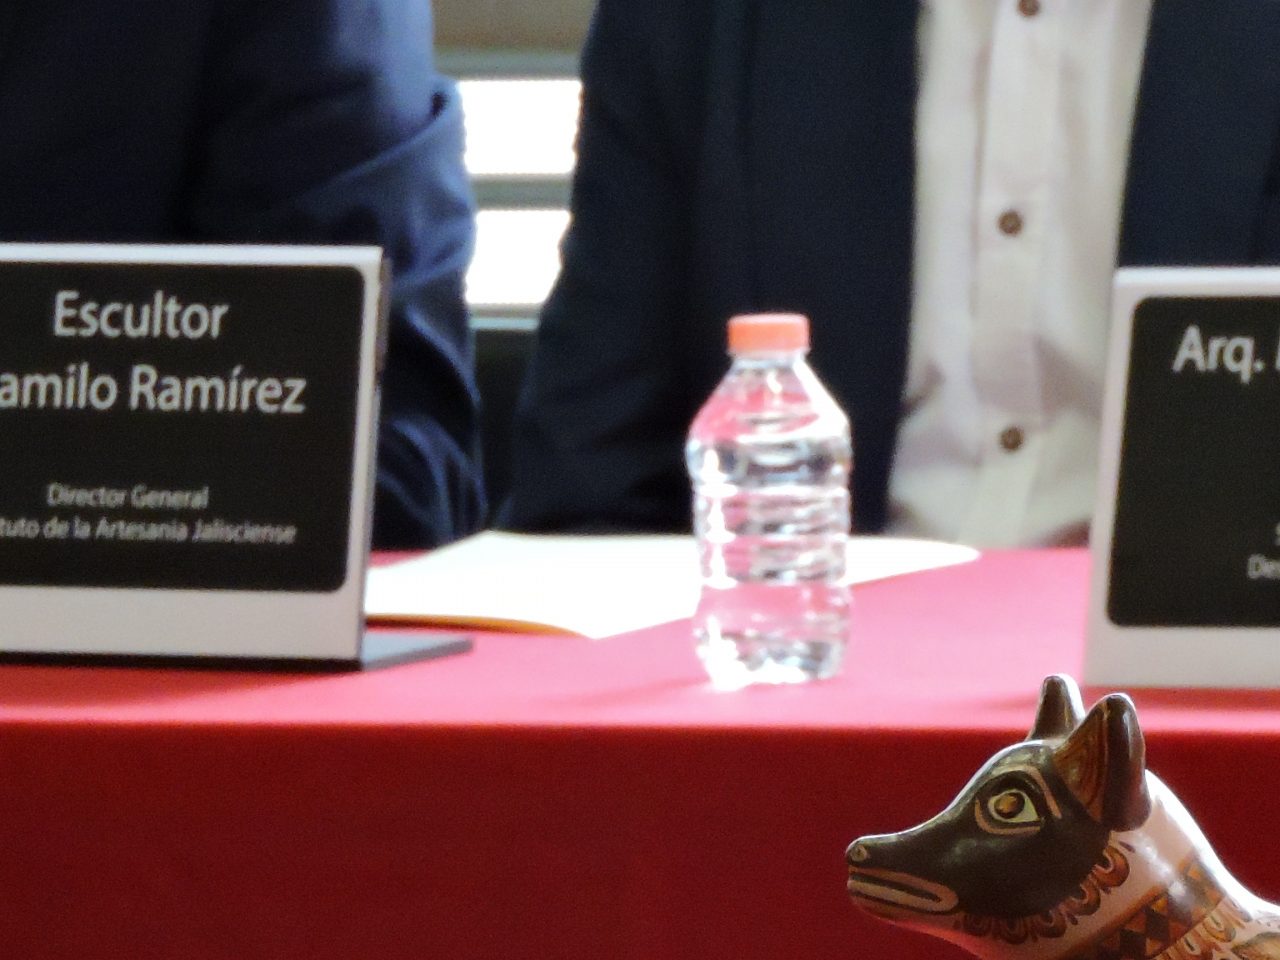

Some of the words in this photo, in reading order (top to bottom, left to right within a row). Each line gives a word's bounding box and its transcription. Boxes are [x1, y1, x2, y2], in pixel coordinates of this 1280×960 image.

[53, 289, 229, 340] Escultor
[1172, 324, 1265, 384] Arq.
[129, 363, 307, 414] Ramírez
[46, 482, 127, 508] Director
[130, 484, 209, 510] General
[43, 516, 70, 539] de
[73, 515, 92, 539] la
